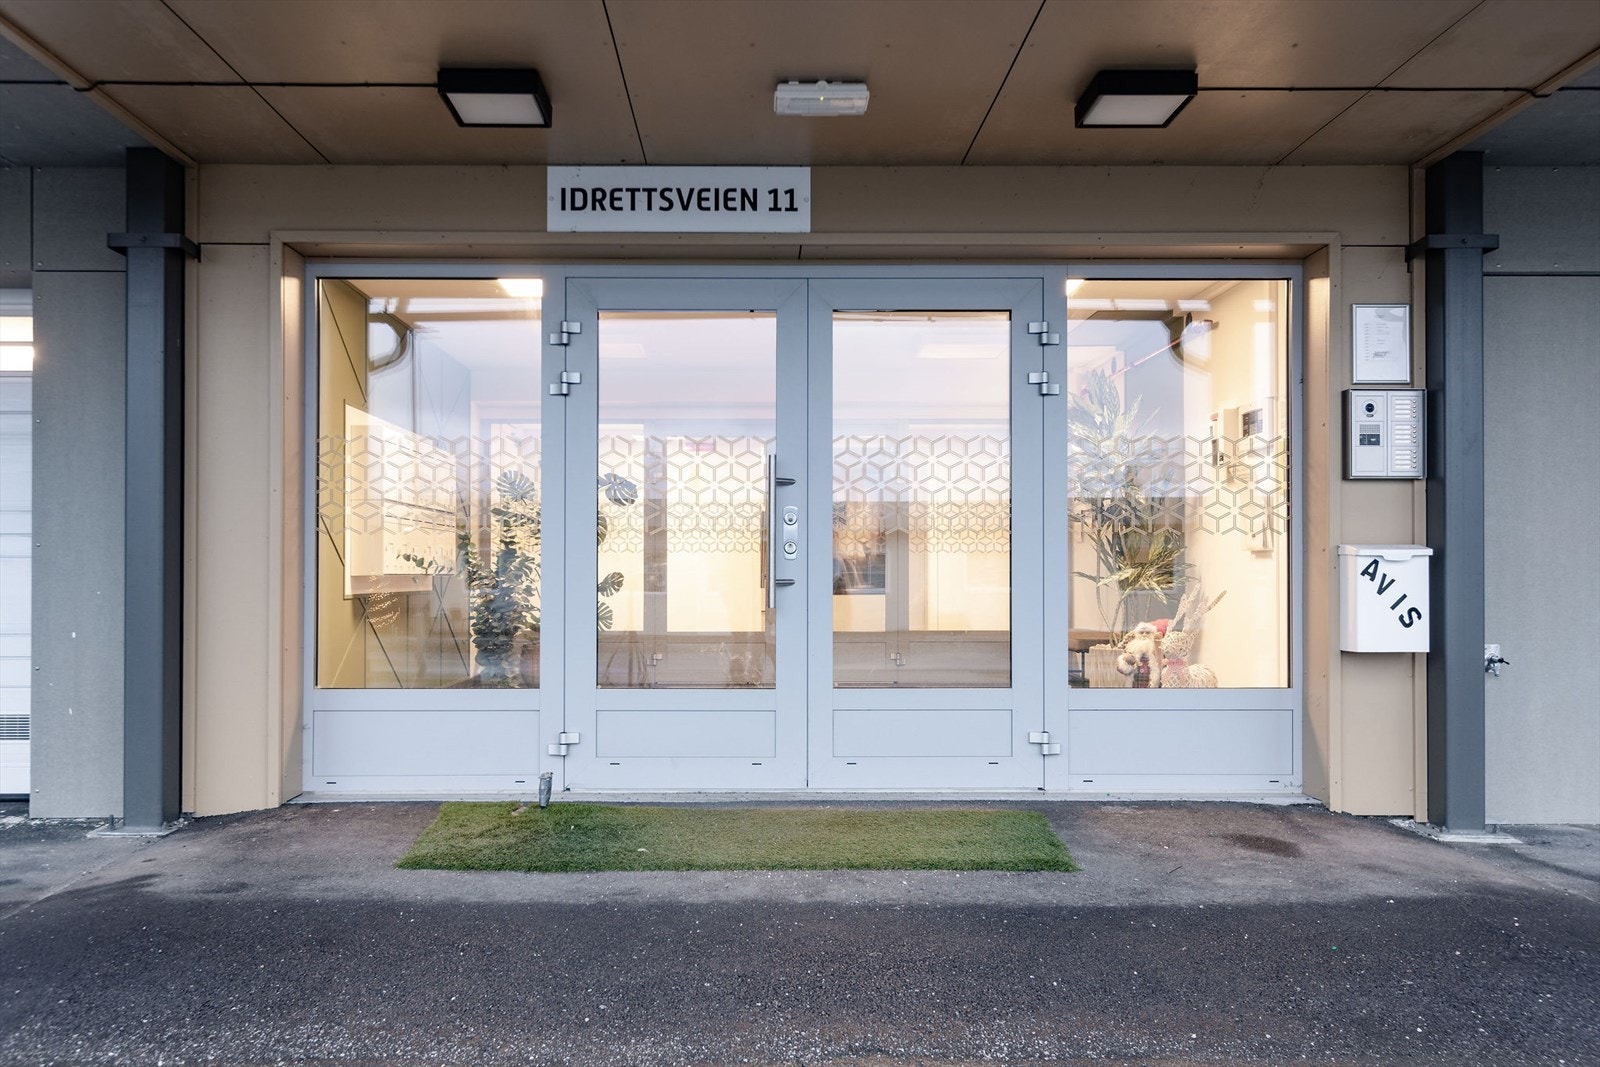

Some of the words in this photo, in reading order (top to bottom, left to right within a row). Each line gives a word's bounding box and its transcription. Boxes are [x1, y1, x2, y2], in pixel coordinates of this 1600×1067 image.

[561, 187, 758, 212] IDRETTSVEIEN
[768, 187, 798, 212] 11
[1360, 558, 1422, 628] AVIS
